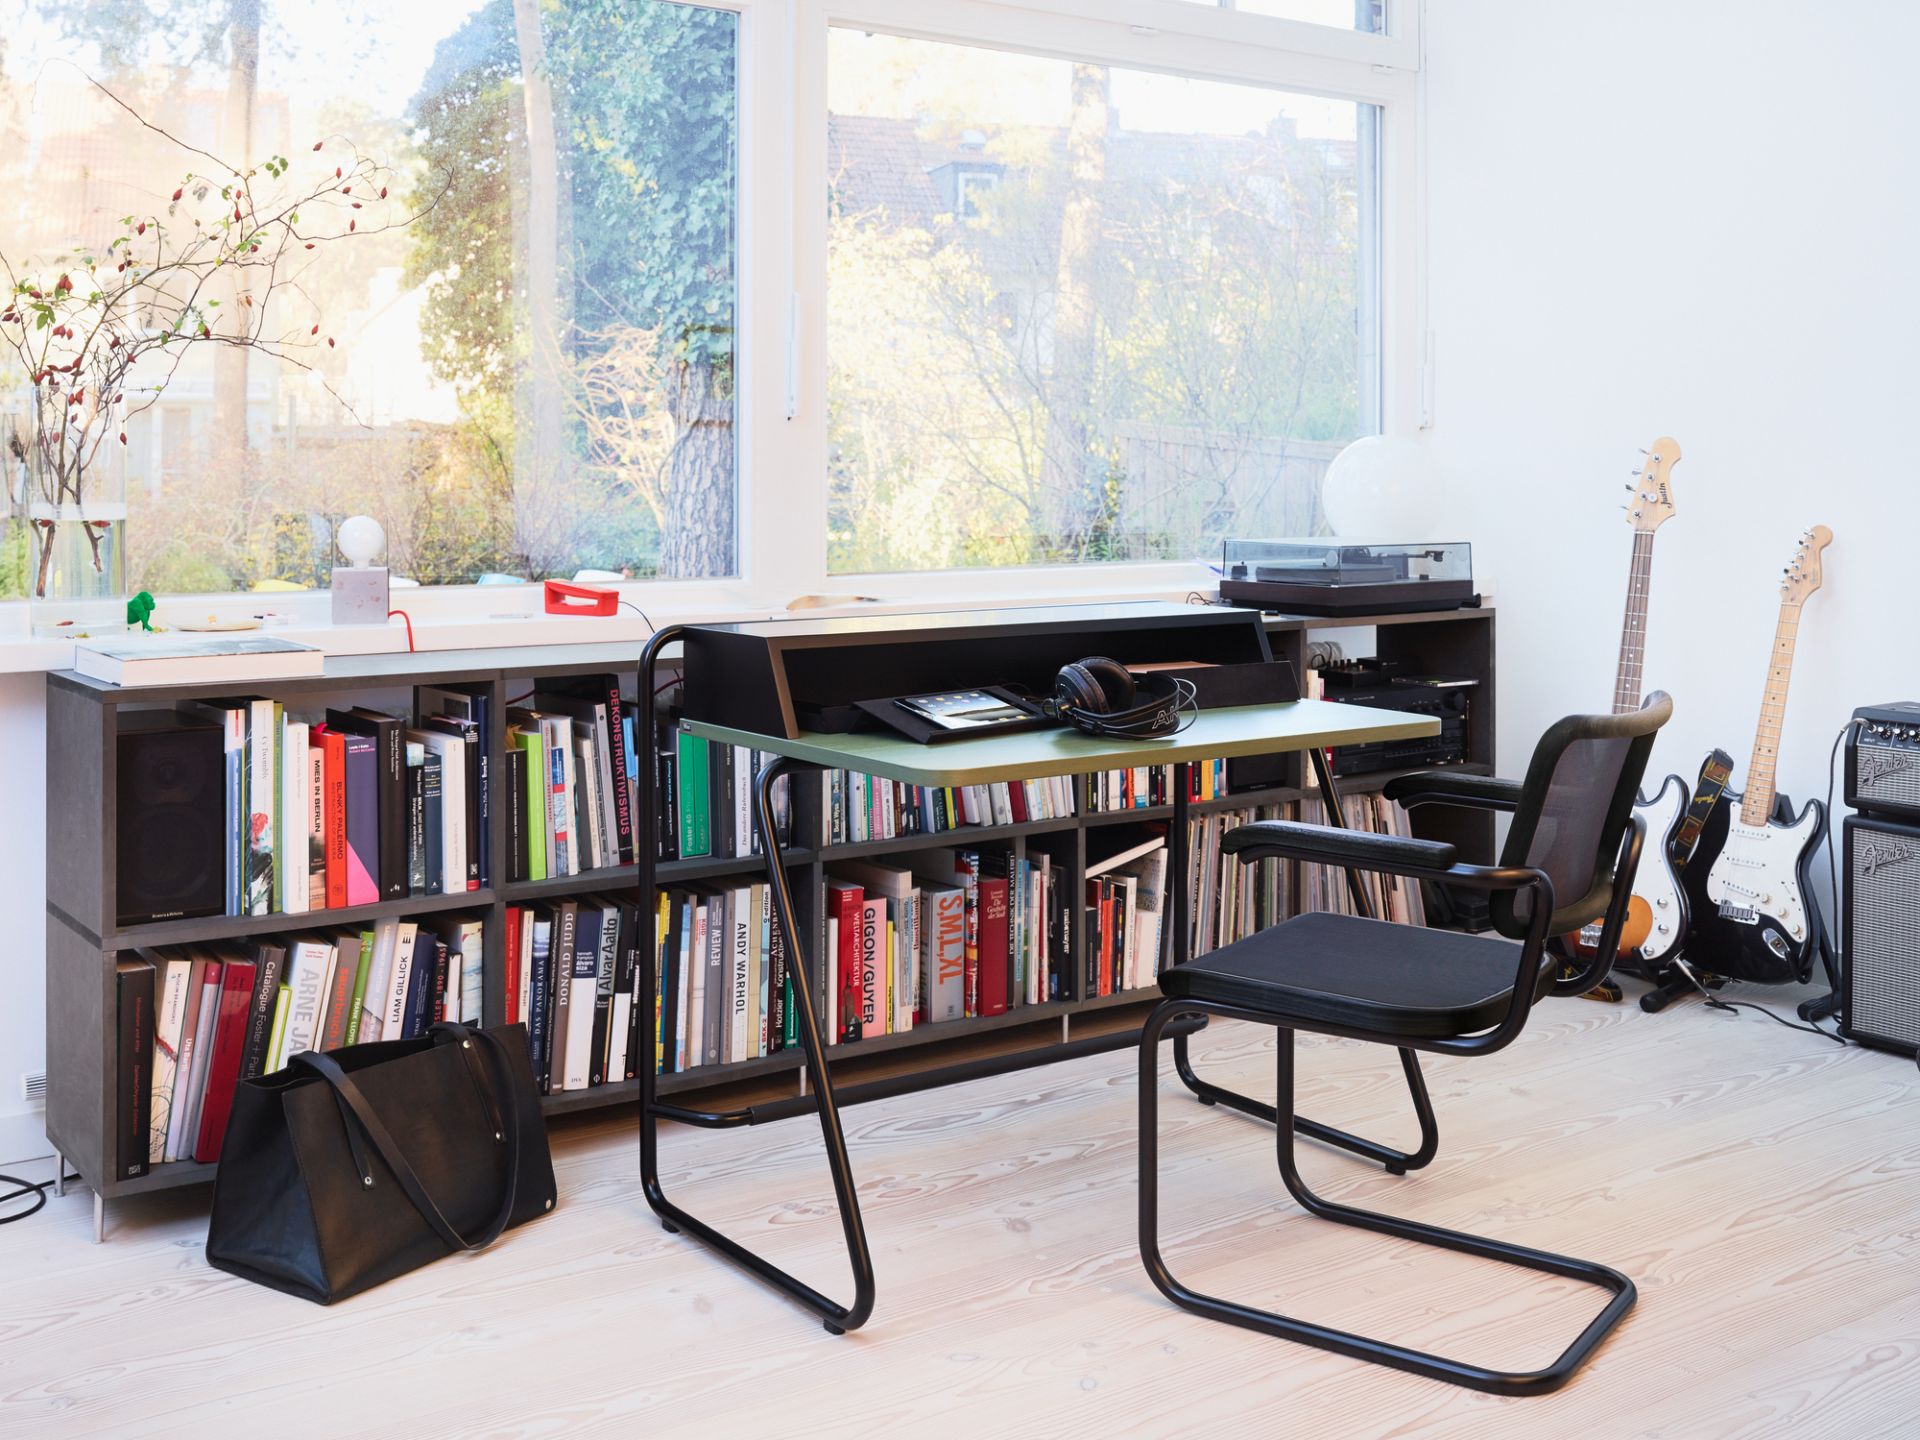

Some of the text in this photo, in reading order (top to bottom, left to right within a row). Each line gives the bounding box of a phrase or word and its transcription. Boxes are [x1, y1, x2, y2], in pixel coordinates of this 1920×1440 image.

[1660, 482, 1672, 509] Justin
[610, 688, 630, 837] DEKONSTRUKTIVISMUS
[1860, 753, 1914, 787] Fender
[314, 786, 320, 796] IN
[685, 814, 692, 825] 40
[1862, 842, 1915, 876] Fender
[437, 948, 446, 966] 1965
[560, 912, 574, 1006] DONALD JUDD
[710, 930, 722, 966] REVIEW
[776, 934, 784, 988] Konstrukt
[852, 912, 860, 986] WELTARCHITEKTUR
[936, 895, 964, 985] S,M,L,XL
[259, 960, 276, 1012] Catalogue
[436, 974, 444, 994] 1890
[536, 960, 545, 1012] PANORAMA
[735, 922, 748, 1016] ANDY WARHOL
[863, 907, 877, 1025] GIGON/GUYER
[294, 968, 321, 1022] ARNE
[392, 956, 408, 1023] LIAM GILLICK
[252, 1014, 266, 1044] Foster
[288, 1026, 310, 1053] JA
[348, 998, 361, 1044] FRANK LLOYD
[181, 1038, 192, 1072] Uta Barth
